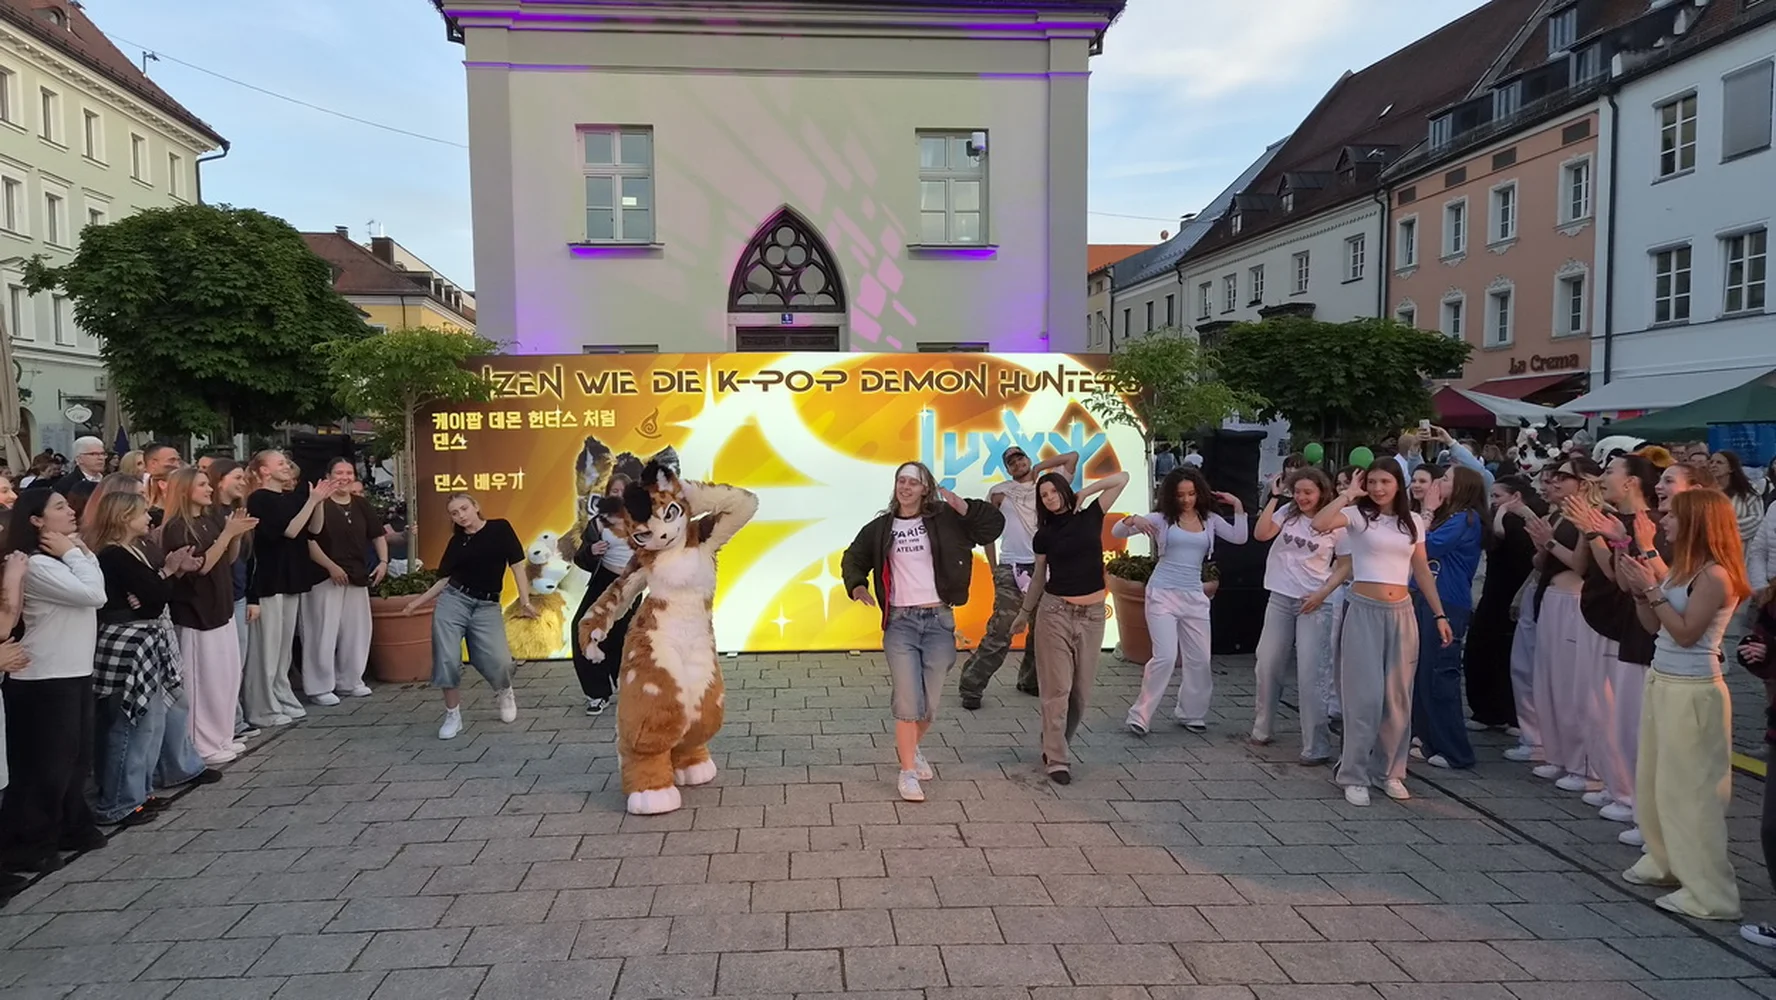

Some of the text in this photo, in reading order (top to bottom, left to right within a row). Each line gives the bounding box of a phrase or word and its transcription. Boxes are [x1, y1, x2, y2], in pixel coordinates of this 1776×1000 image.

[1508, 353, 1579, 375] La Crema
[576, 370, 638, 394] WIE
[652, 370, 704, 393] DIE
[718, 370, 848, 393] K-POP
[860, 364, 987, 397] DEMON
[432, 407, 616, 431] 케이팝 데몬 헌터스 처럼
[432, 432, 468, 451] 댄스
[434, 471, 525, 493] 댄스 배우기
[891, 525, 927, 537] PARIS
[896, 545, 924, 553] ATELIER
